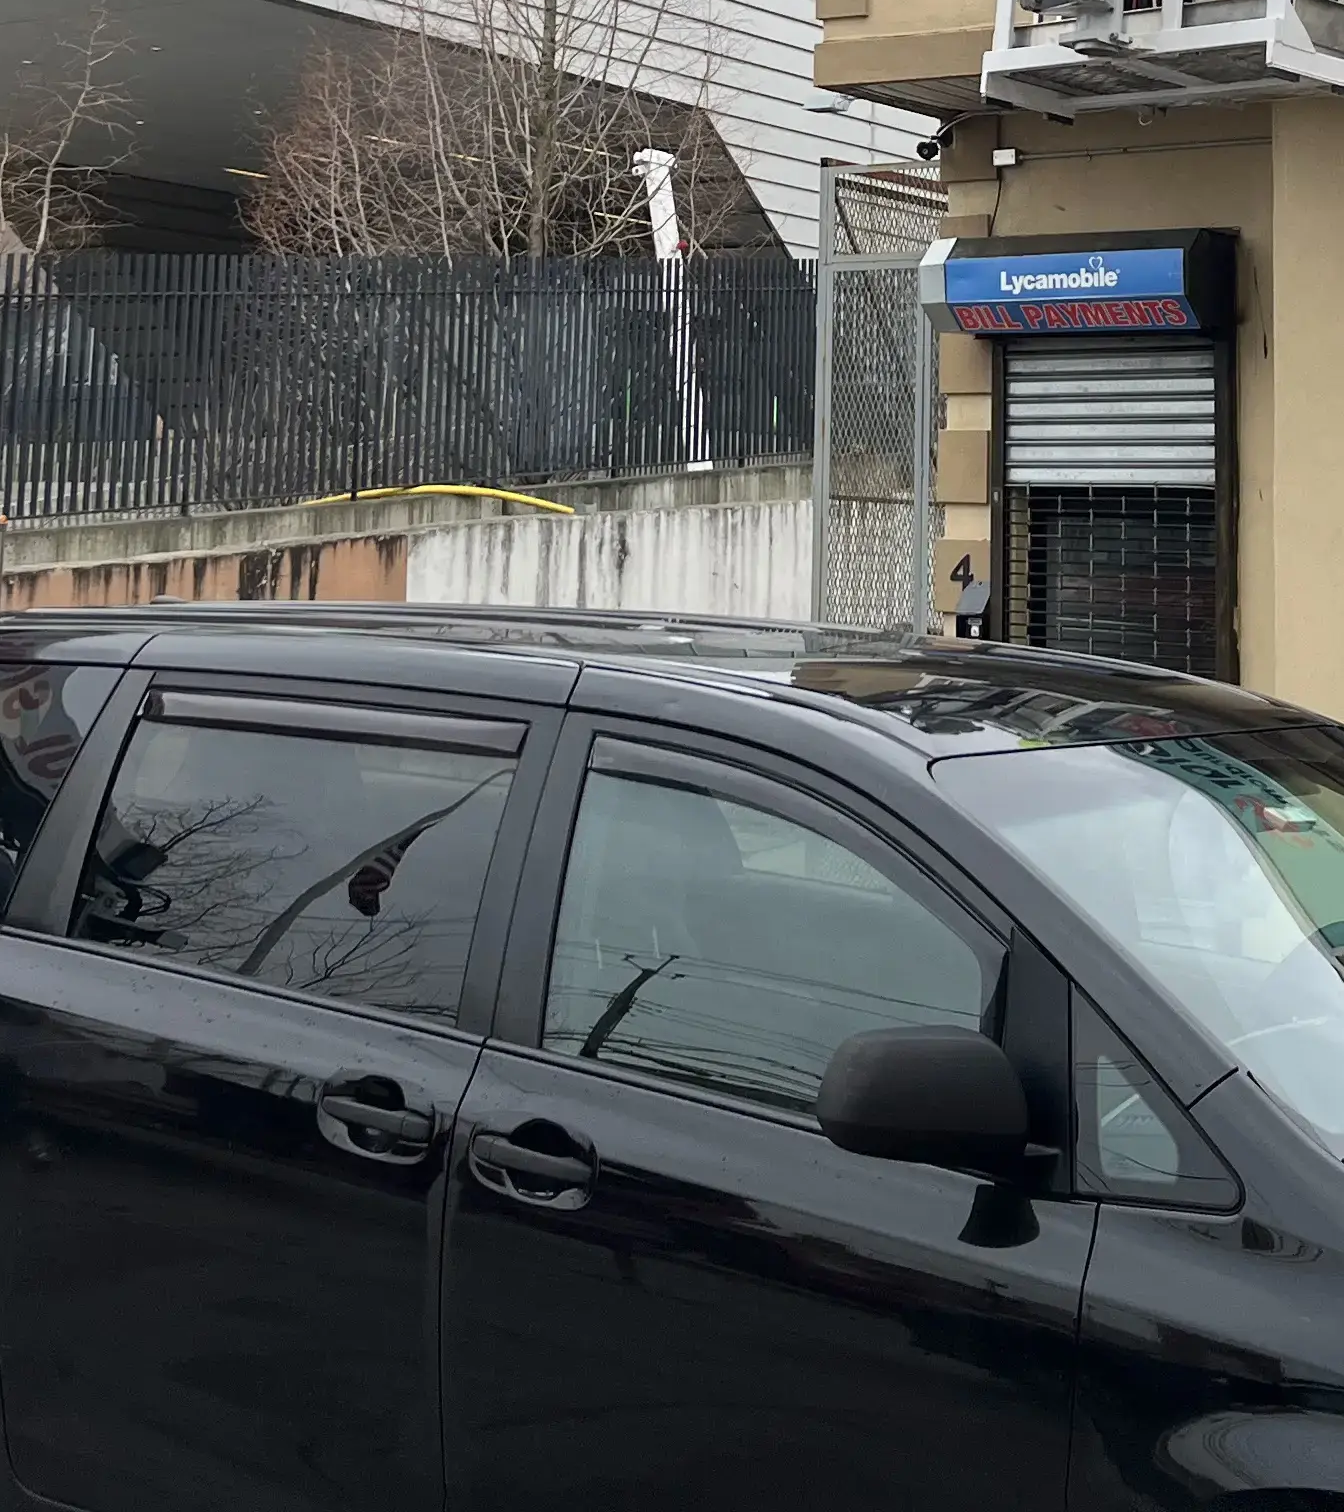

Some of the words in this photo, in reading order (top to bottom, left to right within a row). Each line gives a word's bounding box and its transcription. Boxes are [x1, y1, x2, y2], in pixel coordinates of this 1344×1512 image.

[999, 265, 1119, 296] Lycamobile
[954, 305, 1023, 331] BILL
[1020, 299, 1189, 330] PAYMENTS
[949, 553, 974, 592] 4
